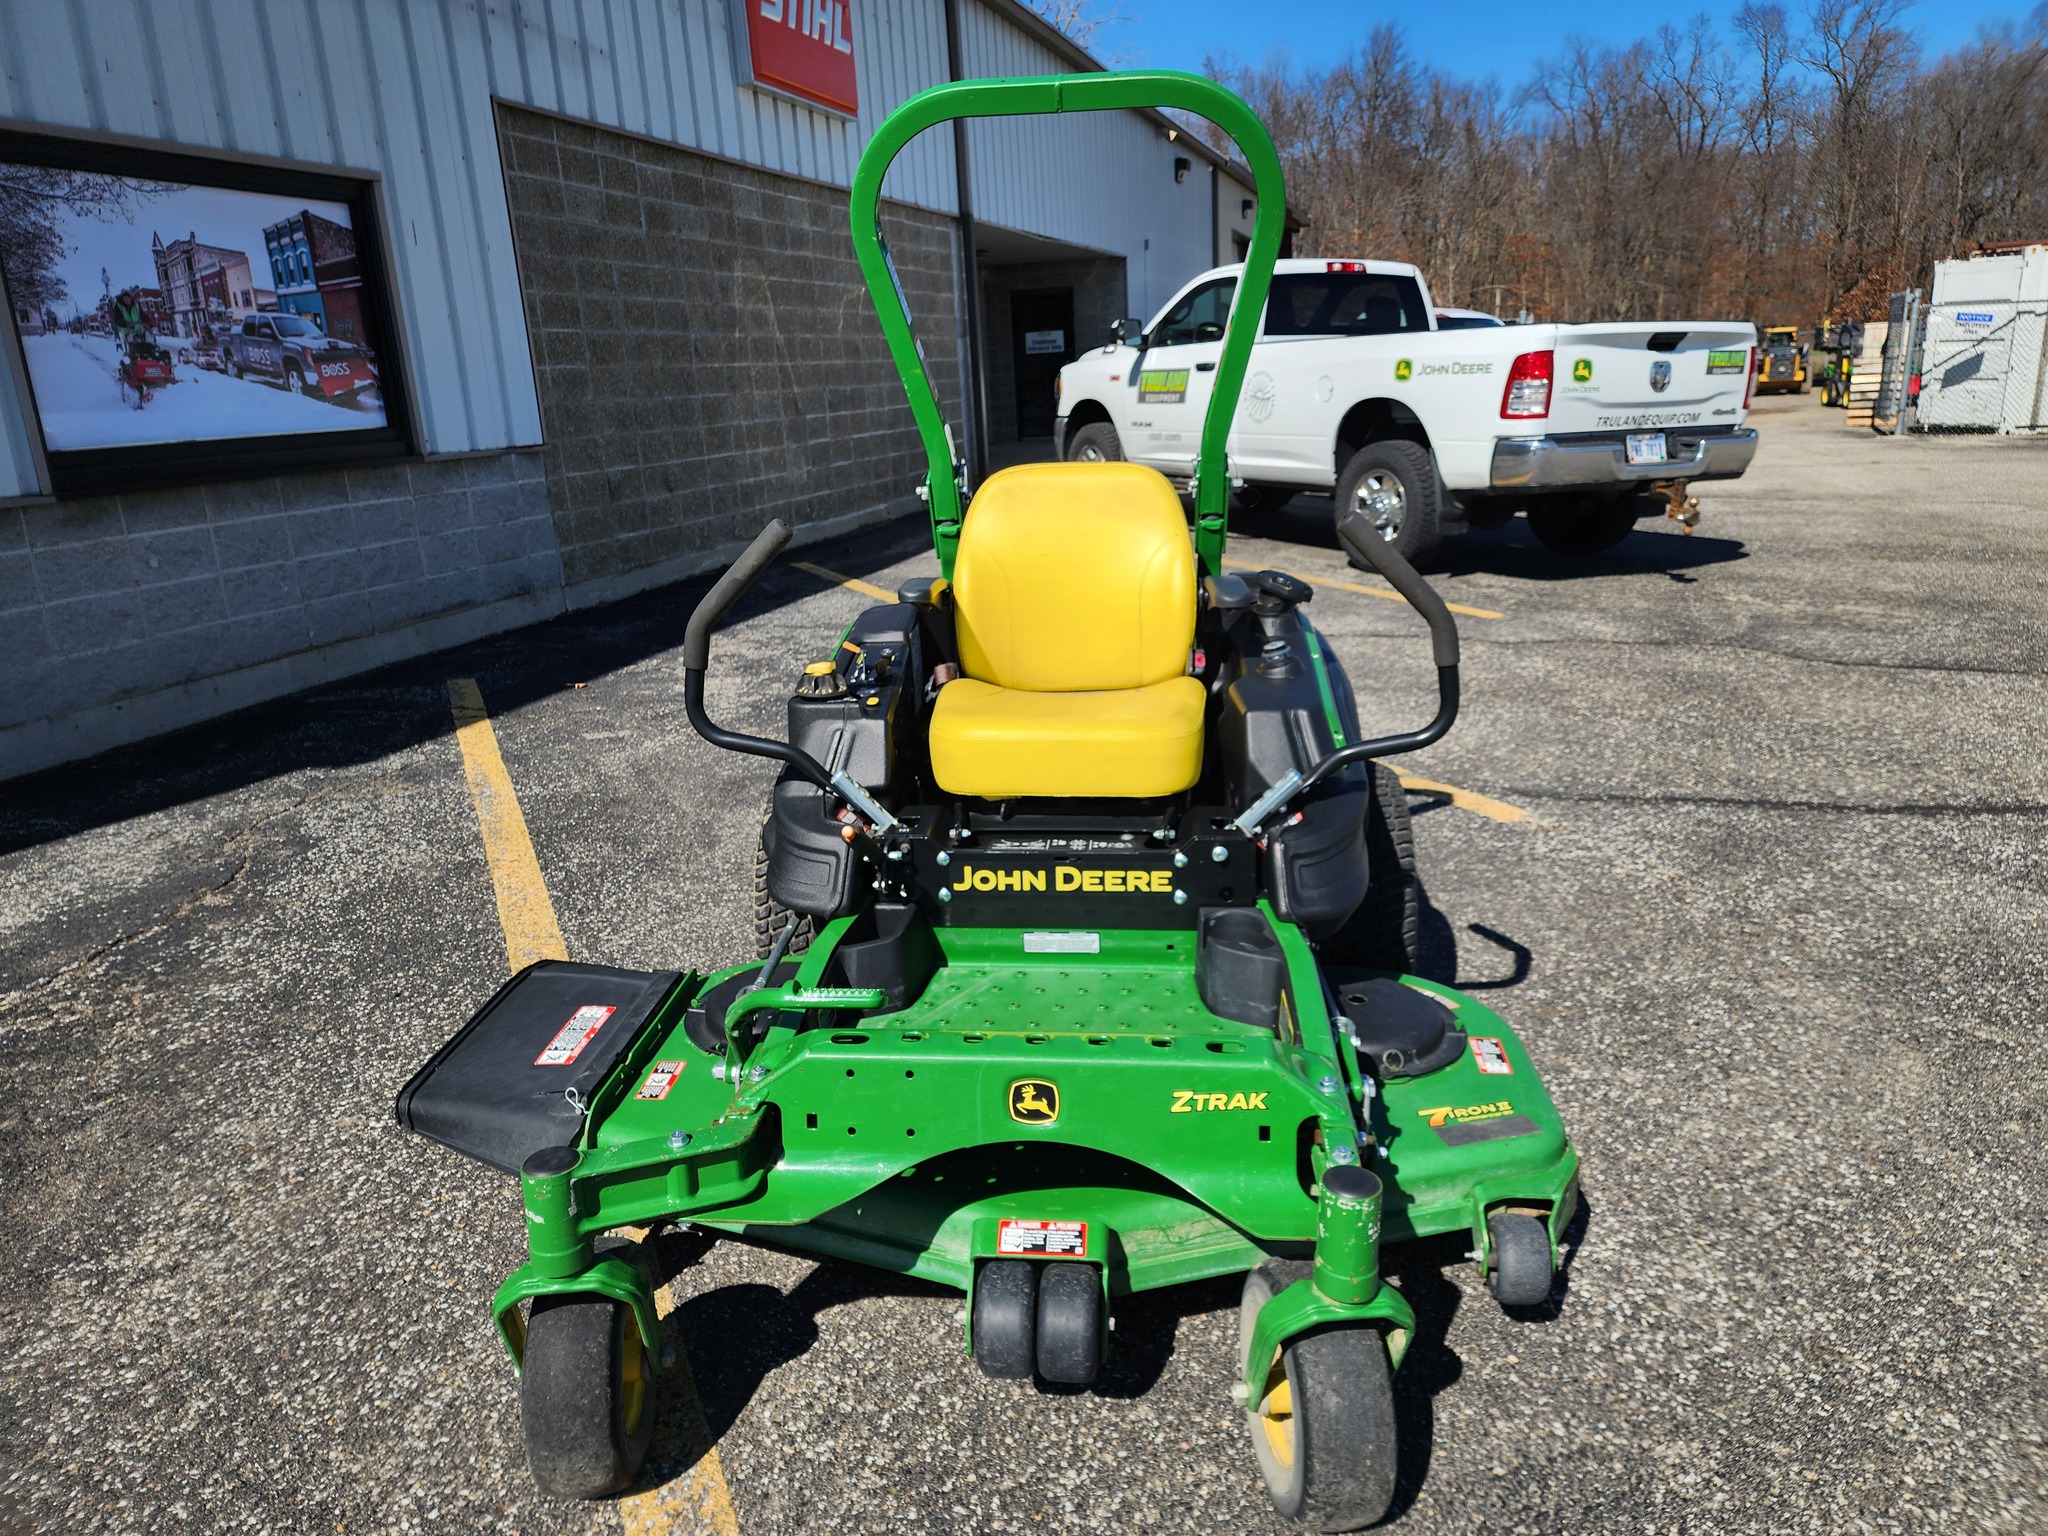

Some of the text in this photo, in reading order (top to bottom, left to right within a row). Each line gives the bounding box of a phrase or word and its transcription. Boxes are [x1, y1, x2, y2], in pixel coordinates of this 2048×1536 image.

[248, 346, 271, 365] BOSS
[321, 362, 350, 377] BOSS
[1417, 362, 1493, 376] JOHN DEERE
[1596, 412, 1701, 427] TRULANDEQUIP.COM
[953, 865, 1173, 892] JOHN DEERE
[1170, 1090, 1269, 1113] ZTRAK
